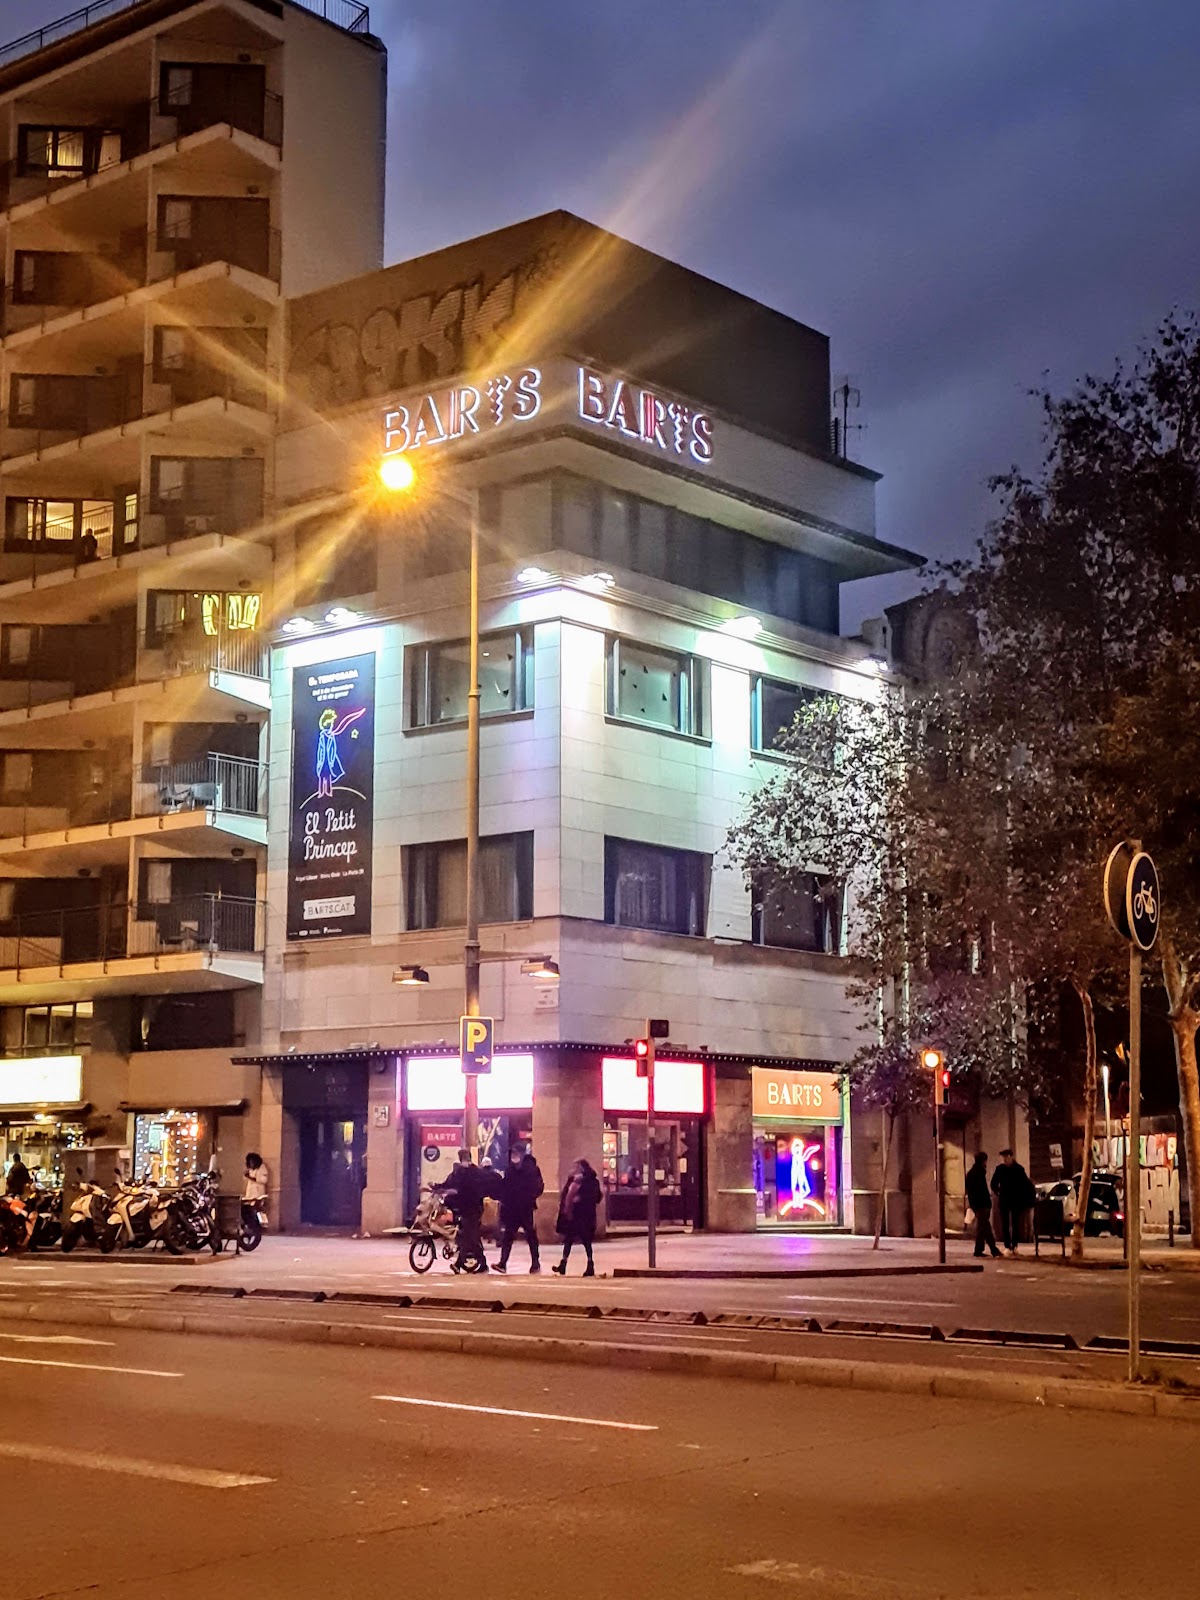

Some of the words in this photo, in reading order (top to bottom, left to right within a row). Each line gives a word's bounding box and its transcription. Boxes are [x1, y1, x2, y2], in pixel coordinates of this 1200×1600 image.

[382, 368, 542, 456] BARTS
[578, 367, 714, 463] BARTS
[305, 811, 320, 835] El
[325, 807, 357, 832] Petit
[467, 1021, 487, 1052] P
[767, 1082, 823, 1107] BARTS
[427, 1132, 456, 1141] BARTS
